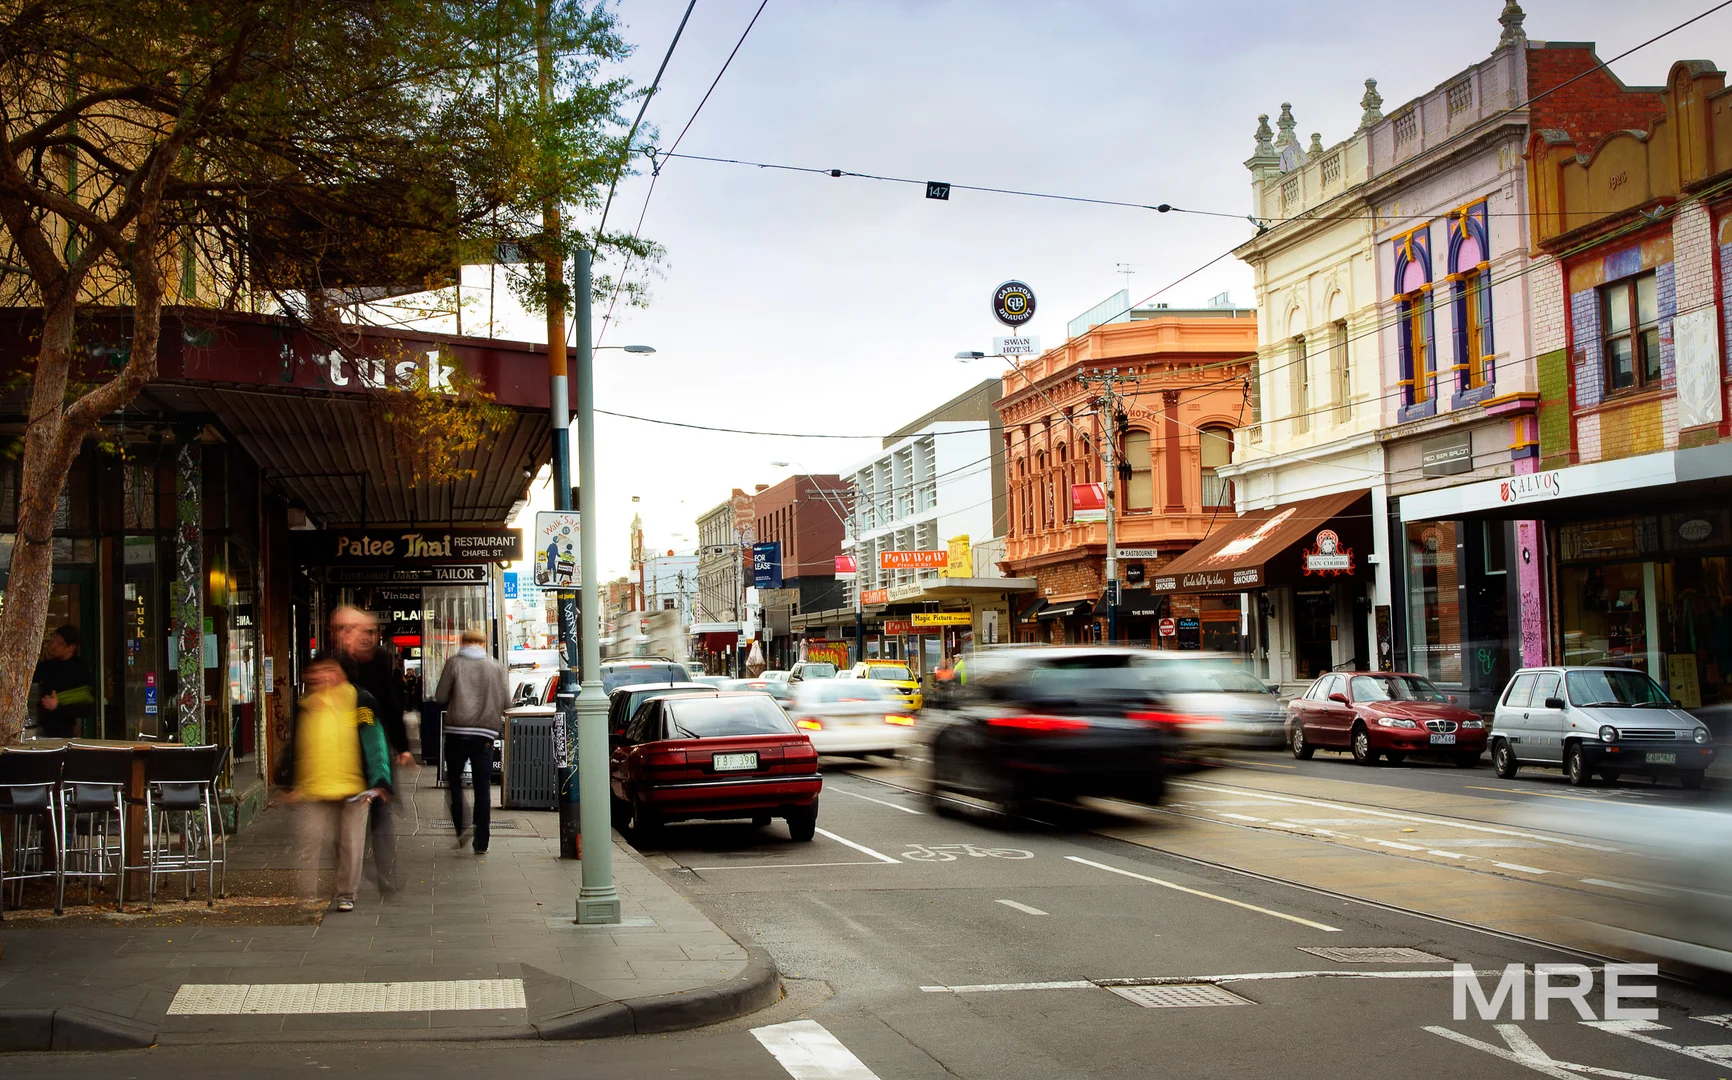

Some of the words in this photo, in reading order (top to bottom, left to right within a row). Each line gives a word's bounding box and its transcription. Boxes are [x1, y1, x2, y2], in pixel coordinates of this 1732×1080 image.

[929, 186, 949, 198] 147
[998, 286, 1032, 300] CARLTON
[998, 308, 1032, 320] DRAUGHT
[1003, 338, 1030, 346] SWAN
[1002, 345, 1033, 354] HOTEL
[328, 349, 459, 396] tusk
[1509, 472, 1560, 503] SALVOS
[543, 519, 563, 536] Walk
[564, 515, 580, 533] Safe
[336, 535, 395, 557] Patee
[400, 532, 453, 558] Thai
[454, 536, 516, 547] RESTAURANT
[461, 549, 490, 557] CHAPEL
[492, 549, 504, 557] ST.
[754, 554, 766, 562] FOR
[884, 551, 946, 563] PoWWoW
[754, 562, 771, 571] LEASE
[435, 568, 475, 580] TAILOR
[1233, 576, 1241, 585] SAN
[1241, 574, 1259, 583] CHURRO
[1155, 583, 1163, 591] SAN
[381, 591, 420, 600] Vintage
[136, 595, 145, 638] tusk
[914, 614, 931, 623] Magic
[933, 613, 952, 621] Picture
[145, 705, 157, 713] VISA
[739, 755, 756, 766] 390
